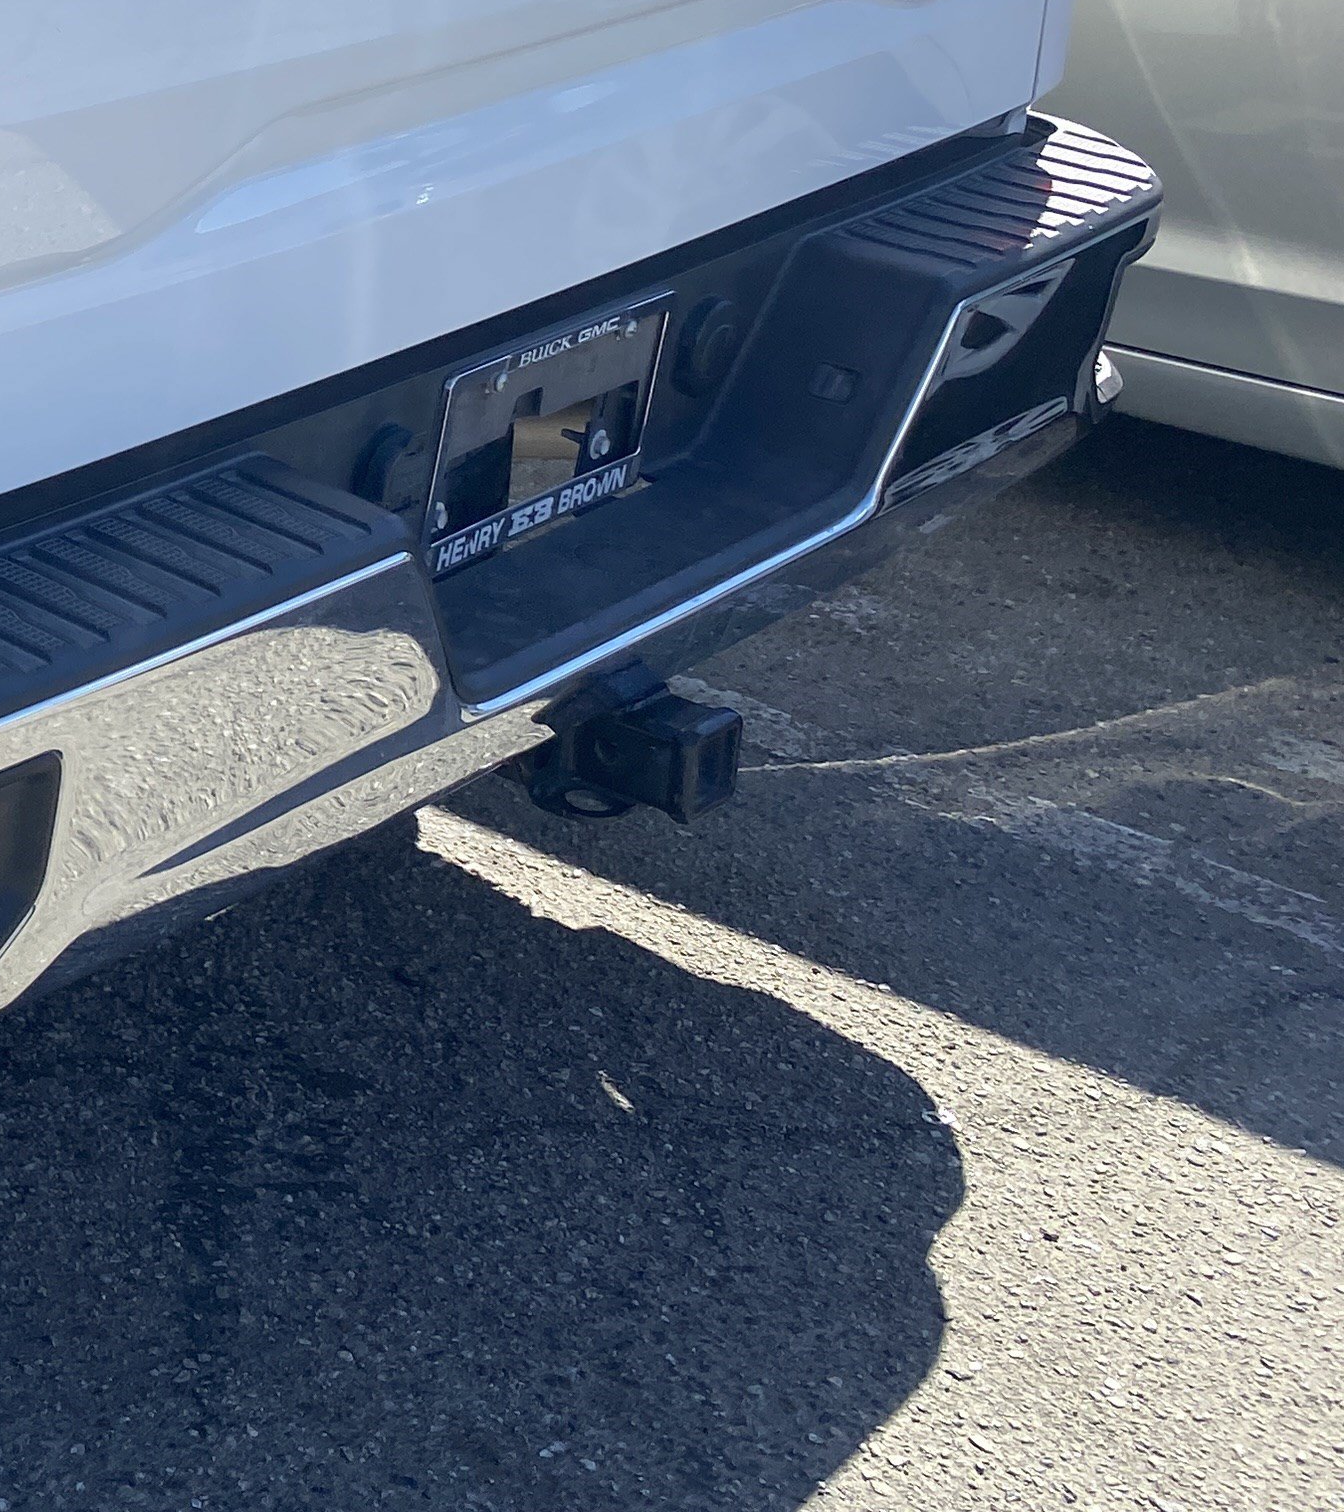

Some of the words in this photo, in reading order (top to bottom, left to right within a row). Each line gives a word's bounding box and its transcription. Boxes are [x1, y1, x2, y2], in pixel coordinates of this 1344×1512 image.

[518, 334, 573, 369] BUICK
[578, 316, 621, 344] GMC
[436, 517, 506, 572] HENRY
[557, 463, 628, 515] BROWN
